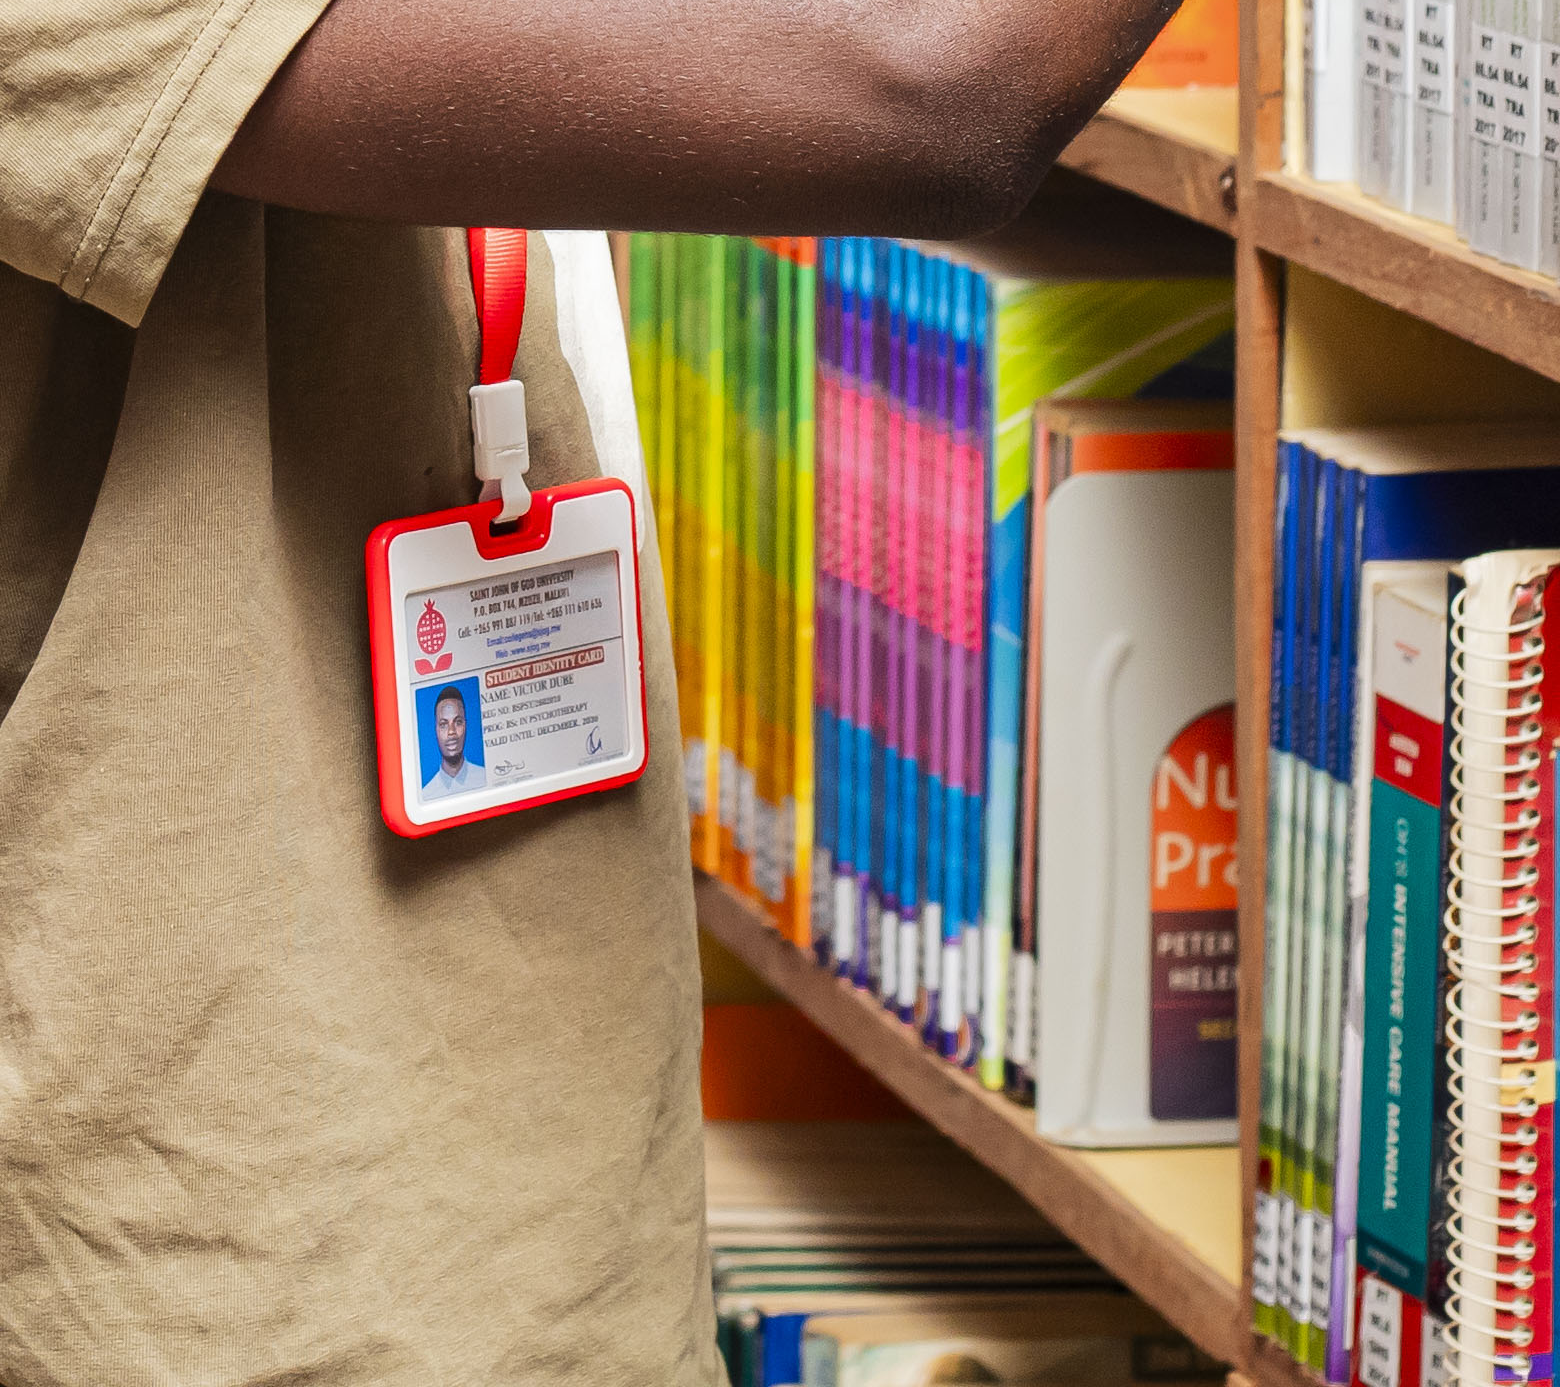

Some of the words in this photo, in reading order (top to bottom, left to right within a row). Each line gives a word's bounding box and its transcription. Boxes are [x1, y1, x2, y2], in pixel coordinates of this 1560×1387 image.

[486, 666, 529, 686] STUDENT
[533, 656, 576, 676] IDENTITY
[578, 649, 603, 664] CARD
[513, 680, 547, 697] VICTOR
[549, 675, 574, 689] DUBE
